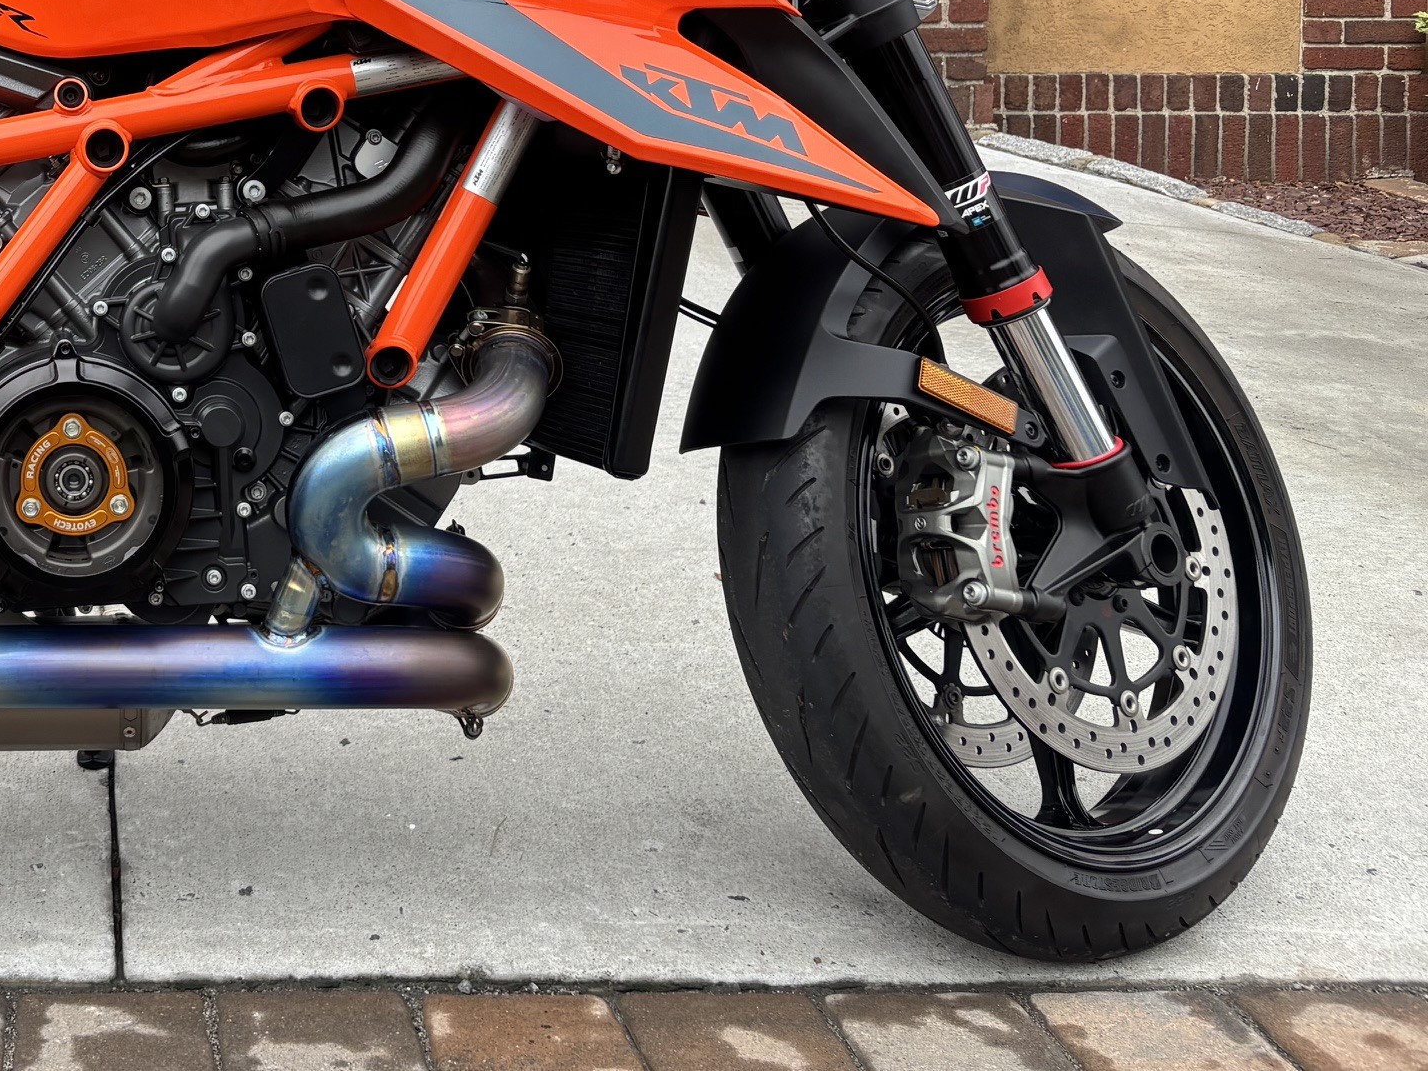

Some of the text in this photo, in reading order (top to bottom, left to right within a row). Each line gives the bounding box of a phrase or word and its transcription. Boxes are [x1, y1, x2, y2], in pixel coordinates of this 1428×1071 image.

[619, 62, 809, 157] KTM
[961, 199, 990, 218] APEX
[25, 439, 52, 479] RACING
[53, 518, 98, 530] EVOTECH
[986, 485, 1004, 568] brembo
